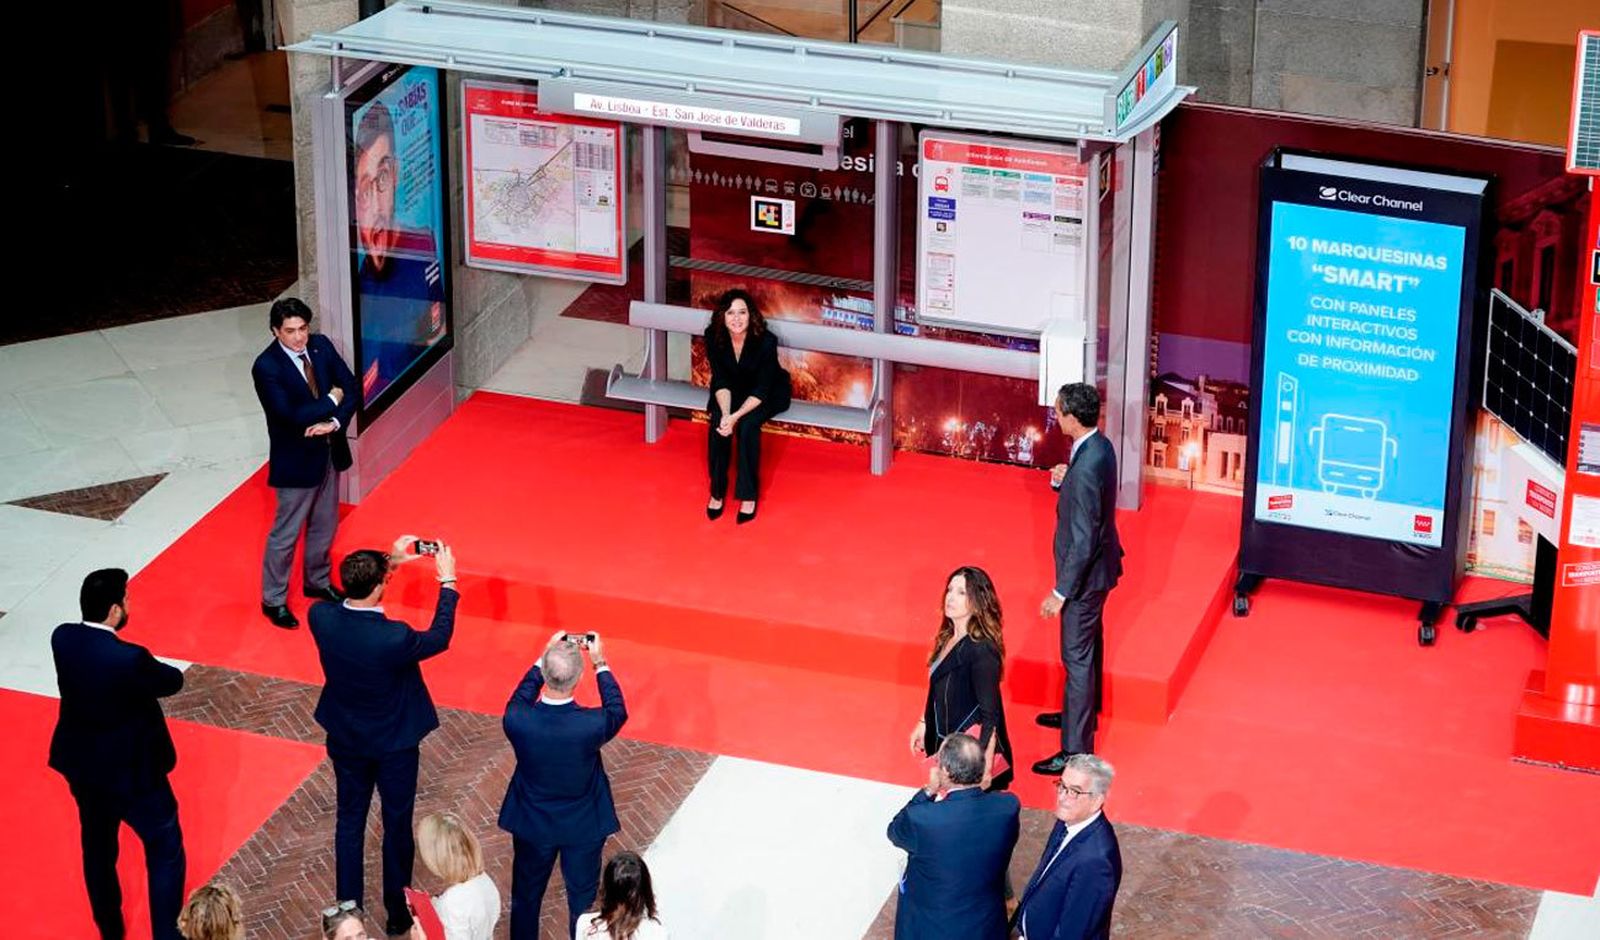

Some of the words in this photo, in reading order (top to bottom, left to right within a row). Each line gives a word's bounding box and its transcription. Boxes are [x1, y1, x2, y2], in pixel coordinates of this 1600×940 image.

[590, 98, 605, 110] Av.
[608, 101, 641, 114] Lisboa
[652, 105, 671, 118] Est.
[674, 108, 694, 120] San
[725, 114, 738, 125] de
[740, 115, 786, 130] Valderas
[1337, 190, 1371, 204] Clear
[1372, 195, 1424, 212] Channel
[1287, 236, 1307, 250] 10
[1312, 239, 1448, 270] MARQUESINAS
[1310, 296, 1346, 311] CON
[1350, 301, 1417, 322] PANELES
[1307, 314, 1418, 341] INTERACTIVOS
[1287, 330, 1322, 346] CON
[1325, 334, 1436, 362] INFORMACIÓN
[1298, 353, 1319, 368] DE
[1322, 357, 1419, 382] PROXIMIDAD
